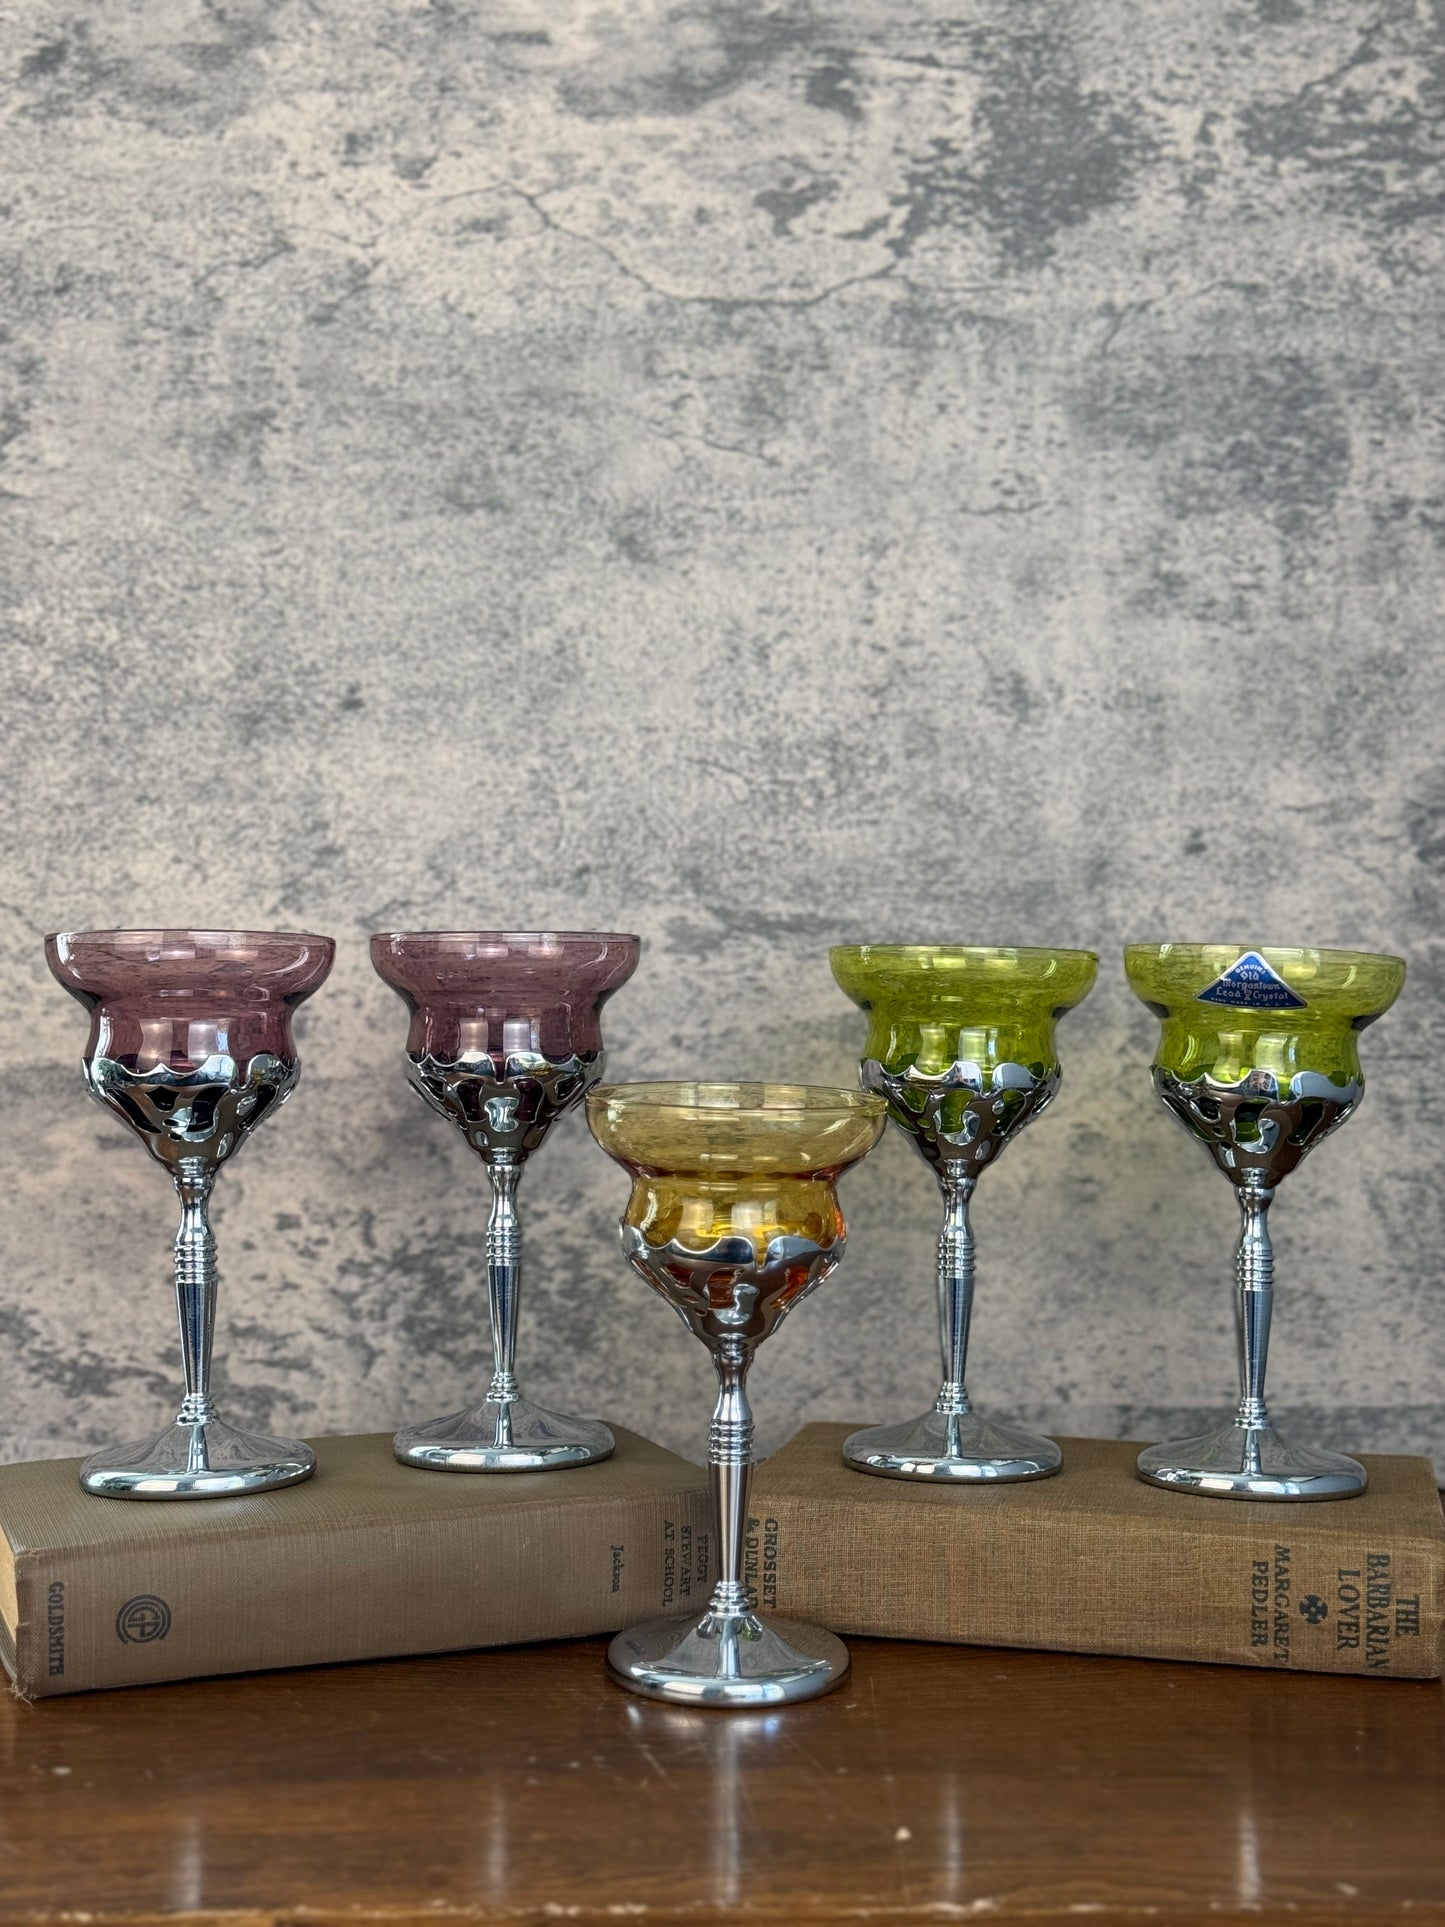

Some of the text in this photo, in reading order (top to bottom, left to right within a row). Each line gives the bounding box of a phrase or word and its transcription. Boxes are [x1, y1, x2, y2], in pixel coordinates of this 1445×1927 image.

[1216, 987, 1241, 998] Lead
[1252, 991, 1289, 1002] Crystal
[1222, 979, 1281, 991] Morgantown
[663, 1520, 675, 1607] AT SCHOOL
[681, 1525, 691, 1596] STEWART
[746, 1517, 760, 1534] &
[764, 1518, 779, 1609] GROSSET
[48, 1581, 64, 1676] GOLDSMITH
[1251, 1560, 1269, 1647] PEDLER
[1273, 1544, 1291, 1663] MARGARET
[1337, 1568, 1361, 1651] LOVER
[1366, 1553, 1391, 1669] BARBARIAN
[1396, 1594, 1420, 1637] THE
